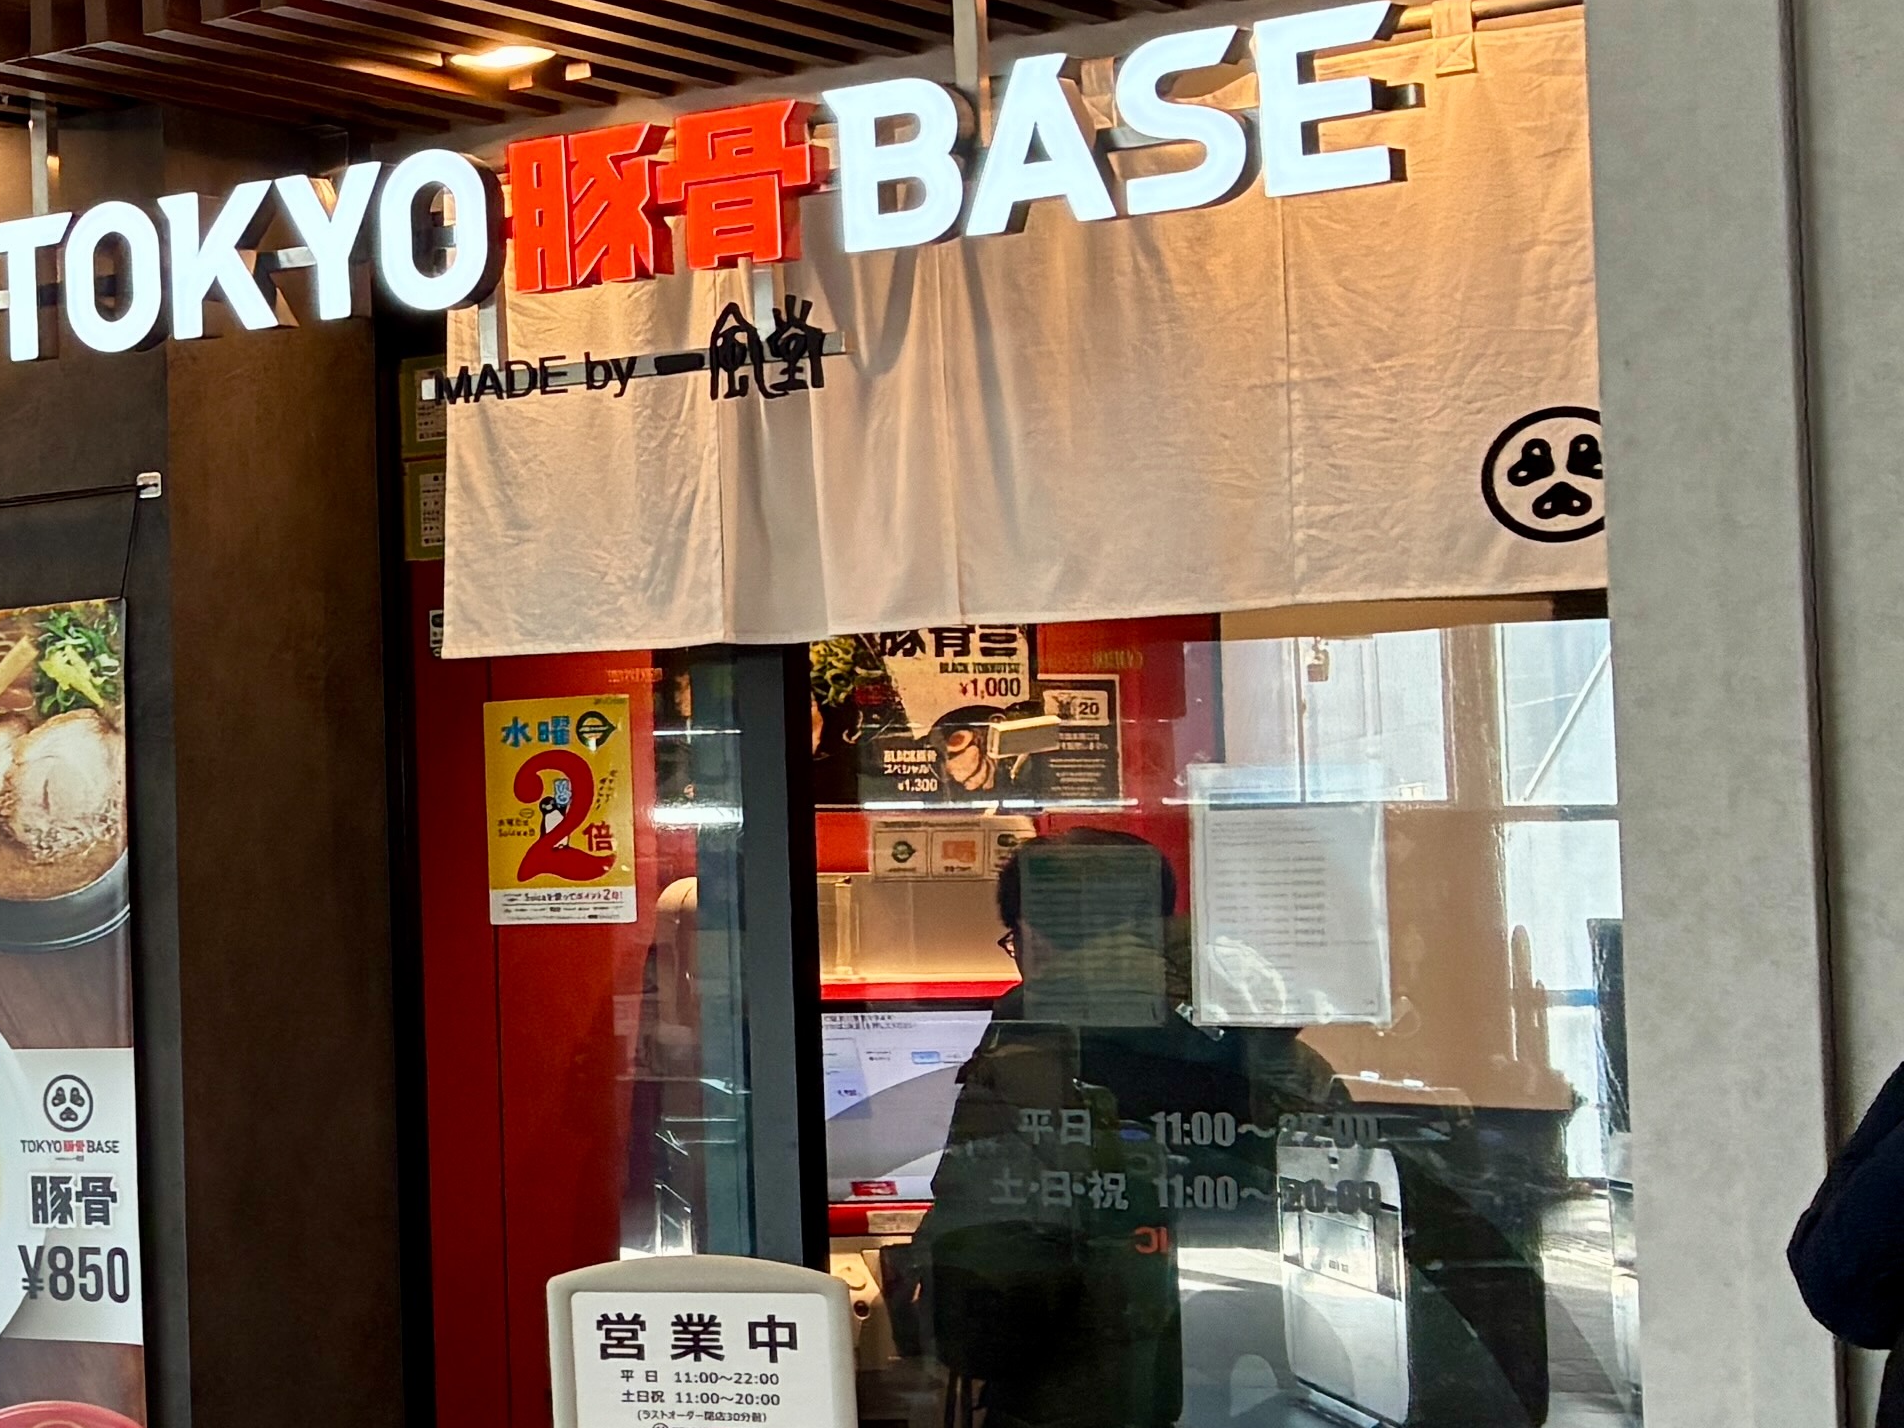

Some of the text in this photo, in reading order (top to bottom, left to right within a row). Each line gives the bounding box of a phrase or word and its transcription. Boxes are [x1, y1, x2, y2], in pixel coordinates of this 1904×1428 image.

[434, 354, 568, 406] MADE
[586, 351, 636, 401] by
[513, 749, 617, 883] 2
[582, 821, 615, 852] 倍
[1017, 1108, 1092, 1147] 平日
[31, 1174, 118, 1227] 豚骨
[18, 1245, 130, 1304] ¥850
[596, 1312, 798, 1363] 営業中
[620, 1369, 658, 1383] 平日
[621, 1389, 665, 1403] 土日祝
